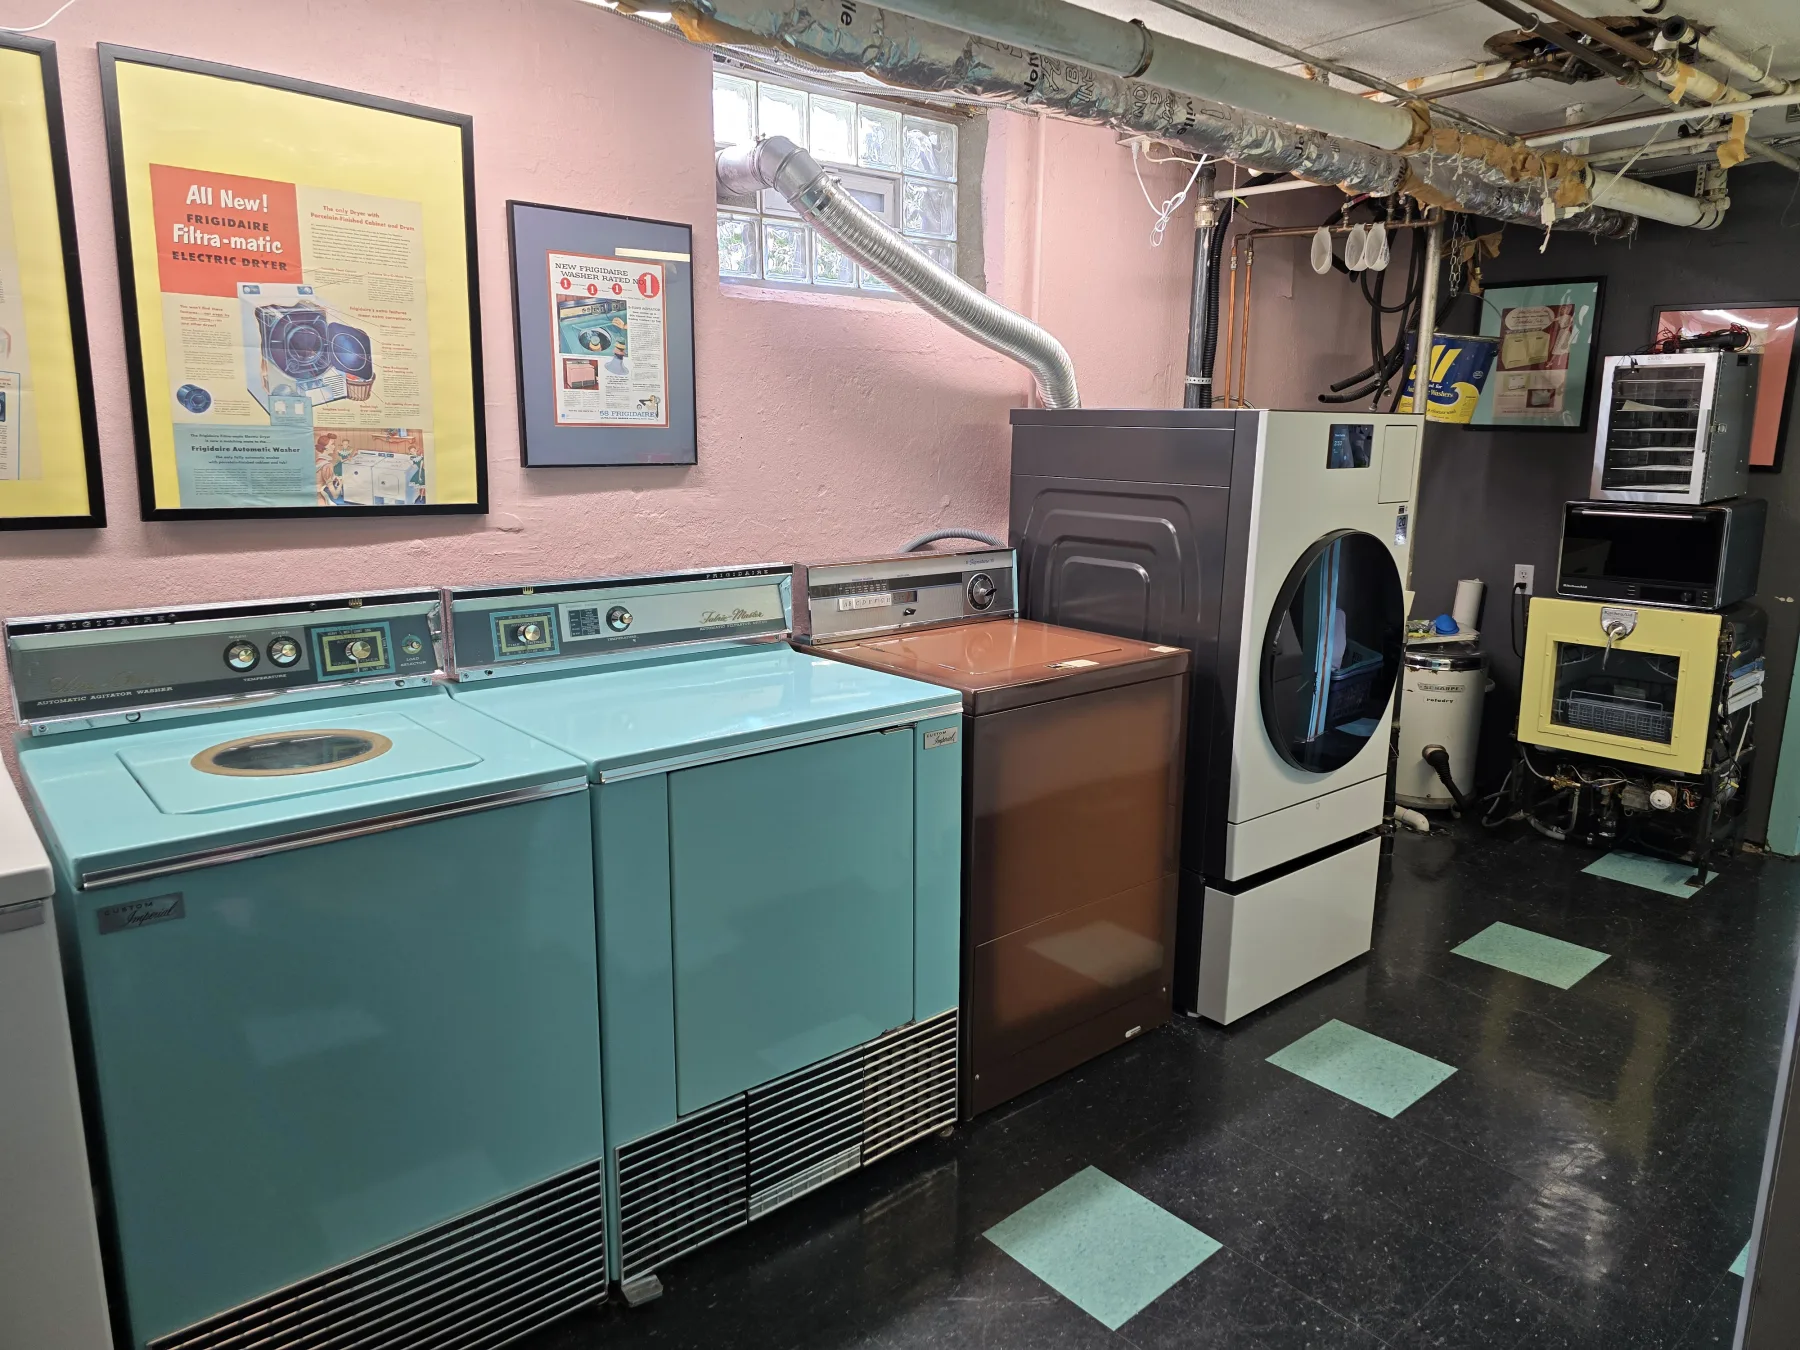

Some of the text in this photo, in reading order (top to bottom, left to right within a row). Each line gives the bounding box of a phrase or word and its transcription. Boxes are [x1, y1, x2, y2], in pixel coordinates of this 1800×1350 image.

[186, 184, 268, 213] All New!
[335, 207, 348, 215] only
[349, 209, 366, 217] Dryer
[186, 213, 269, 232] FRIGIDAIRE
[365, 219, 386, 228] Cabinet
[173, 223, 284, 254] Filtra-matic
[172, 251, 288, 271] ELECTRIC DRYER
[555, 263, 629, 277] NEW FRIGIDAIRE
[560, 271, 600, 281] WASHER
[602, 275, 631, 284] RATED
[1431, 389, 1454, 398] Washers
[191, 445, 231, 453] Frigidaire
[232, 445, 271, 453] Automatic
[706, 569, 769, 578] FRIGIDAIRE
[44, 615, 165, 631] FRIGIDAIRE
[243, 674, 287, 682] TEMPERATURE
[37, 686, 173, 706] AUTOMATIC AGITATOR WASHER
[104, 901, 153, 916] CUSTOM
[123, 900, 179, 927] Imperial
